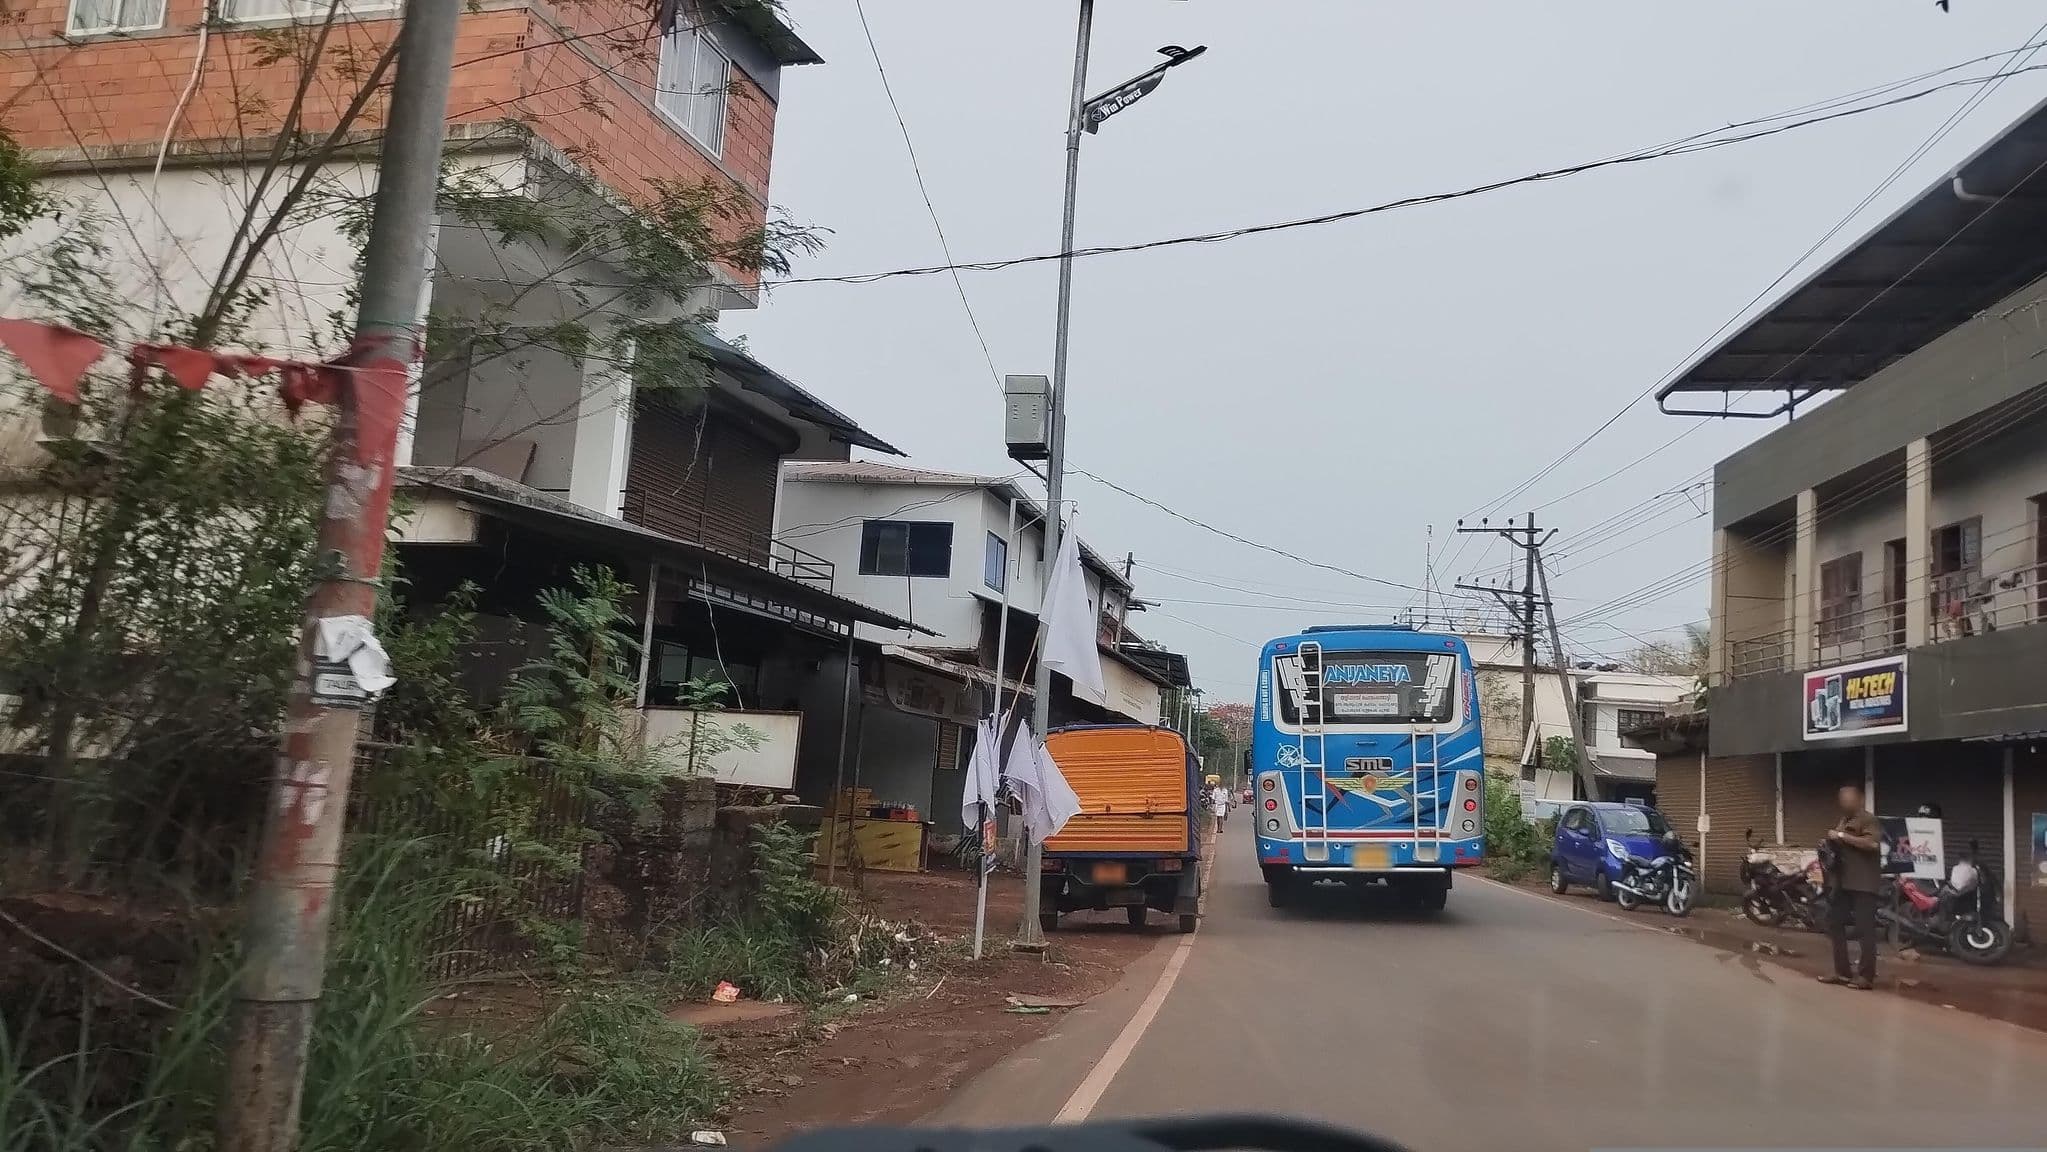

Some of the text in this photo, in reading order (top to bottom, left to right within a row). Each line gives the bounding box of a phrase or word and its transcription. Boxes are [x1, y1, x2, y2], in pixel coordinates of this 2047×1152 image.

[1099, 88, 1142, 117] Win Power
[1323, 664, 1411, 686] ANJANEYA
[1846, 672, 1896, 700] HI-TECH
[1346, 759, 1392, 770] SML
